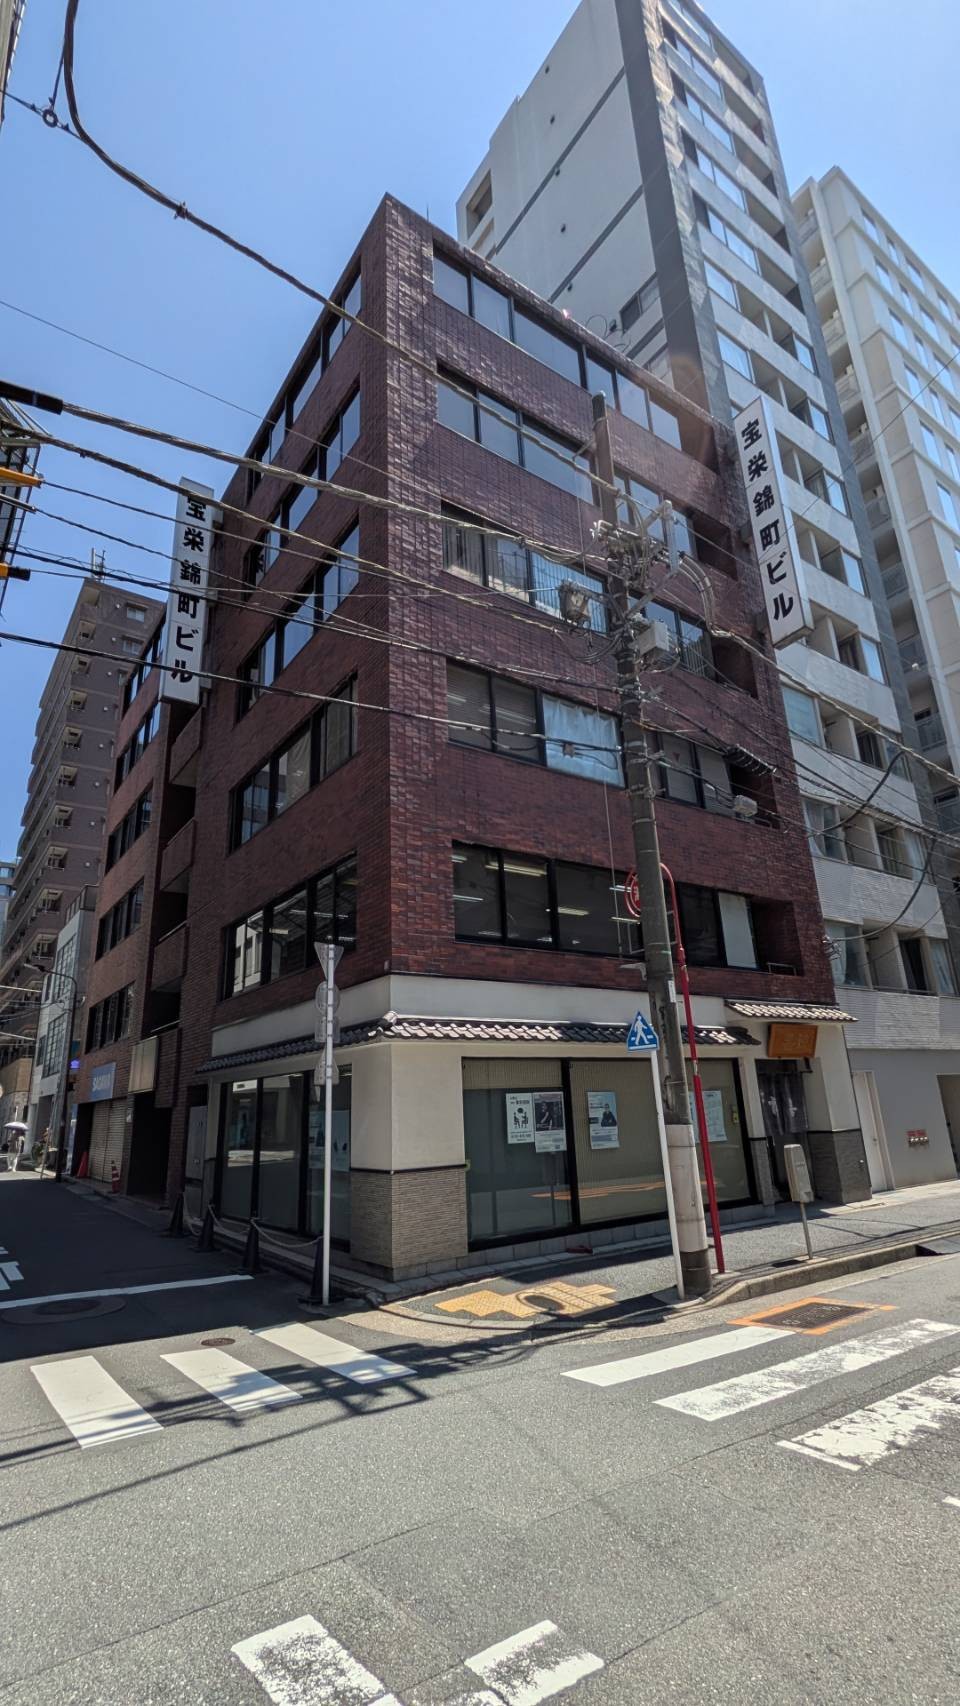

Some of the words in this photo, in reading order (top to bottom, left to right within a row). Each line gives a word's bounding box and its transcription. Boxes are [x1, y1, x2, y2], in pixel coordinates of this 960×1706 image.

[171, 494, 207, 684] 宝栄錦町ビル
[741, 418, 794, 622] 宝栄錦町ビル
